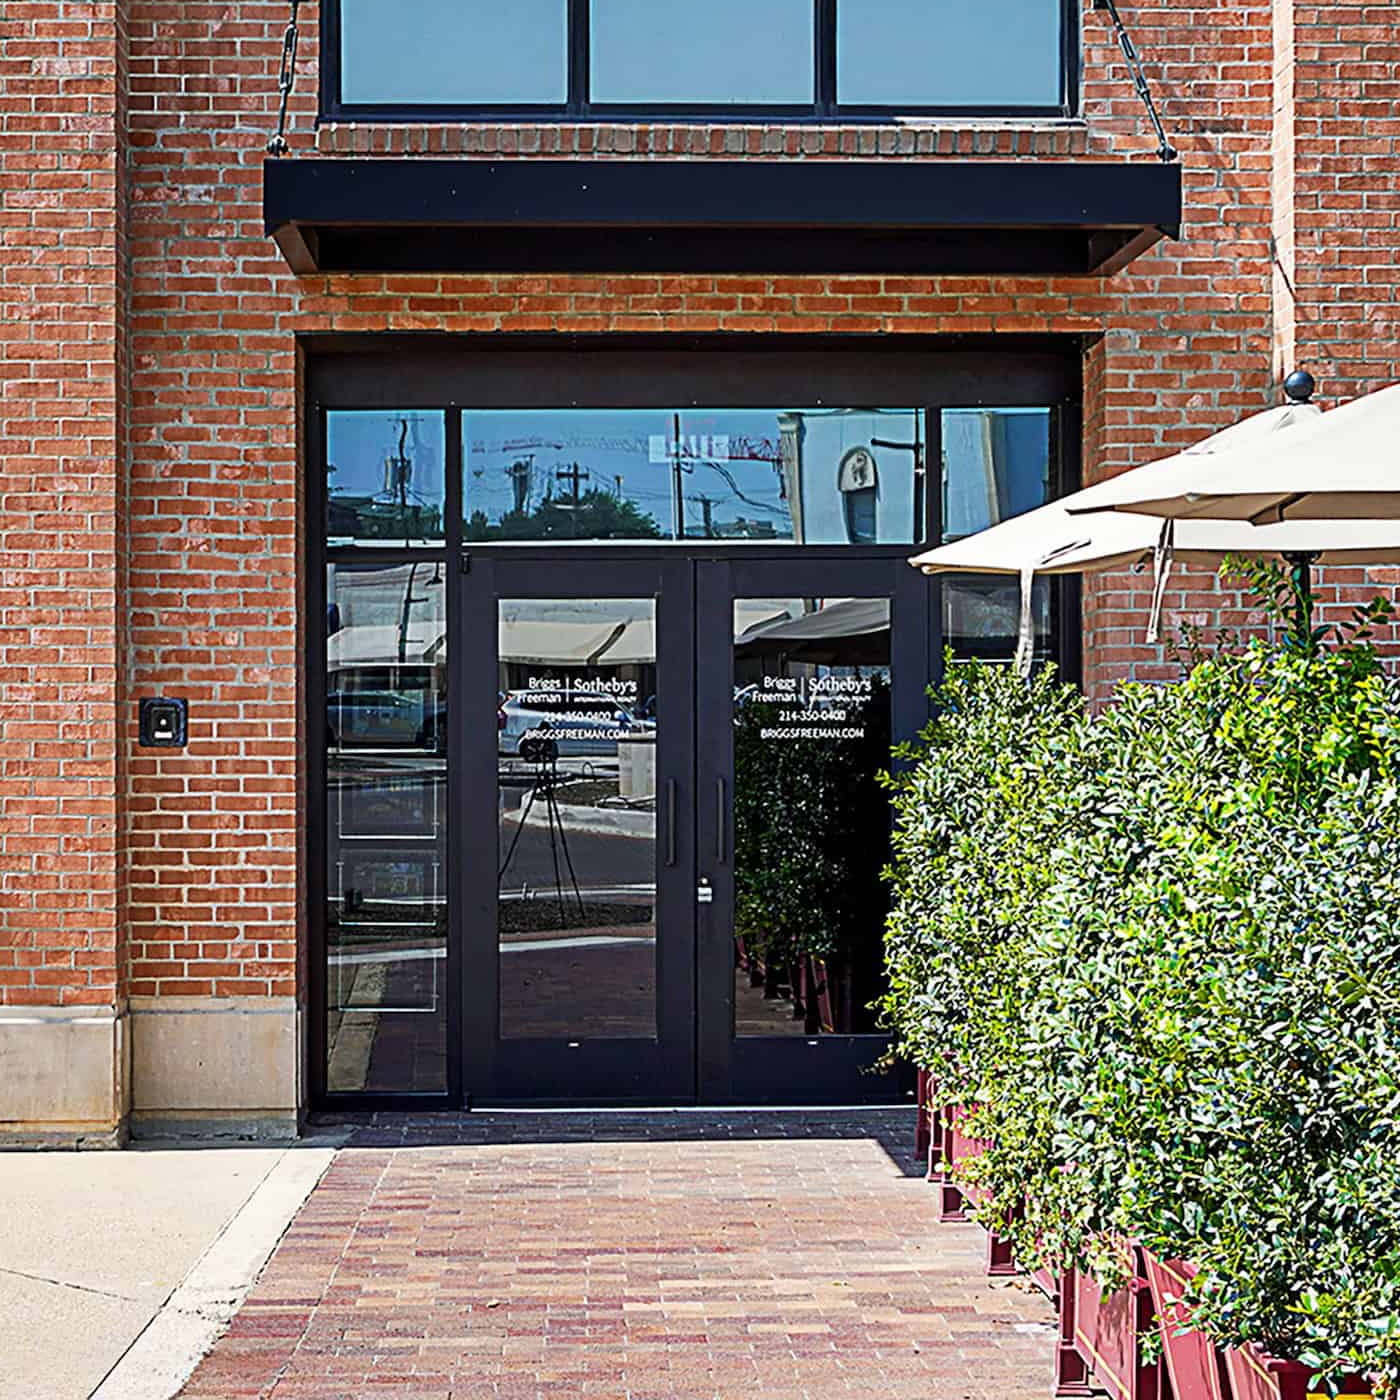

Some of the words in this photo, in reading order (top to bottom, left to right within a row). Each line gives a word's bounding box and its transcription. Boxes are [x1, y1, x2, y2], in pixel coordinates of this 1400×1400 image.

[528, 677, 561, 691] Briggs
[573, 676, 638, 695] Sotheby's
[763, 675, 796, 691] Briggs
[808, 676, 872, 694] Sotheby's
[752, 691, 796, 702] Freeman
